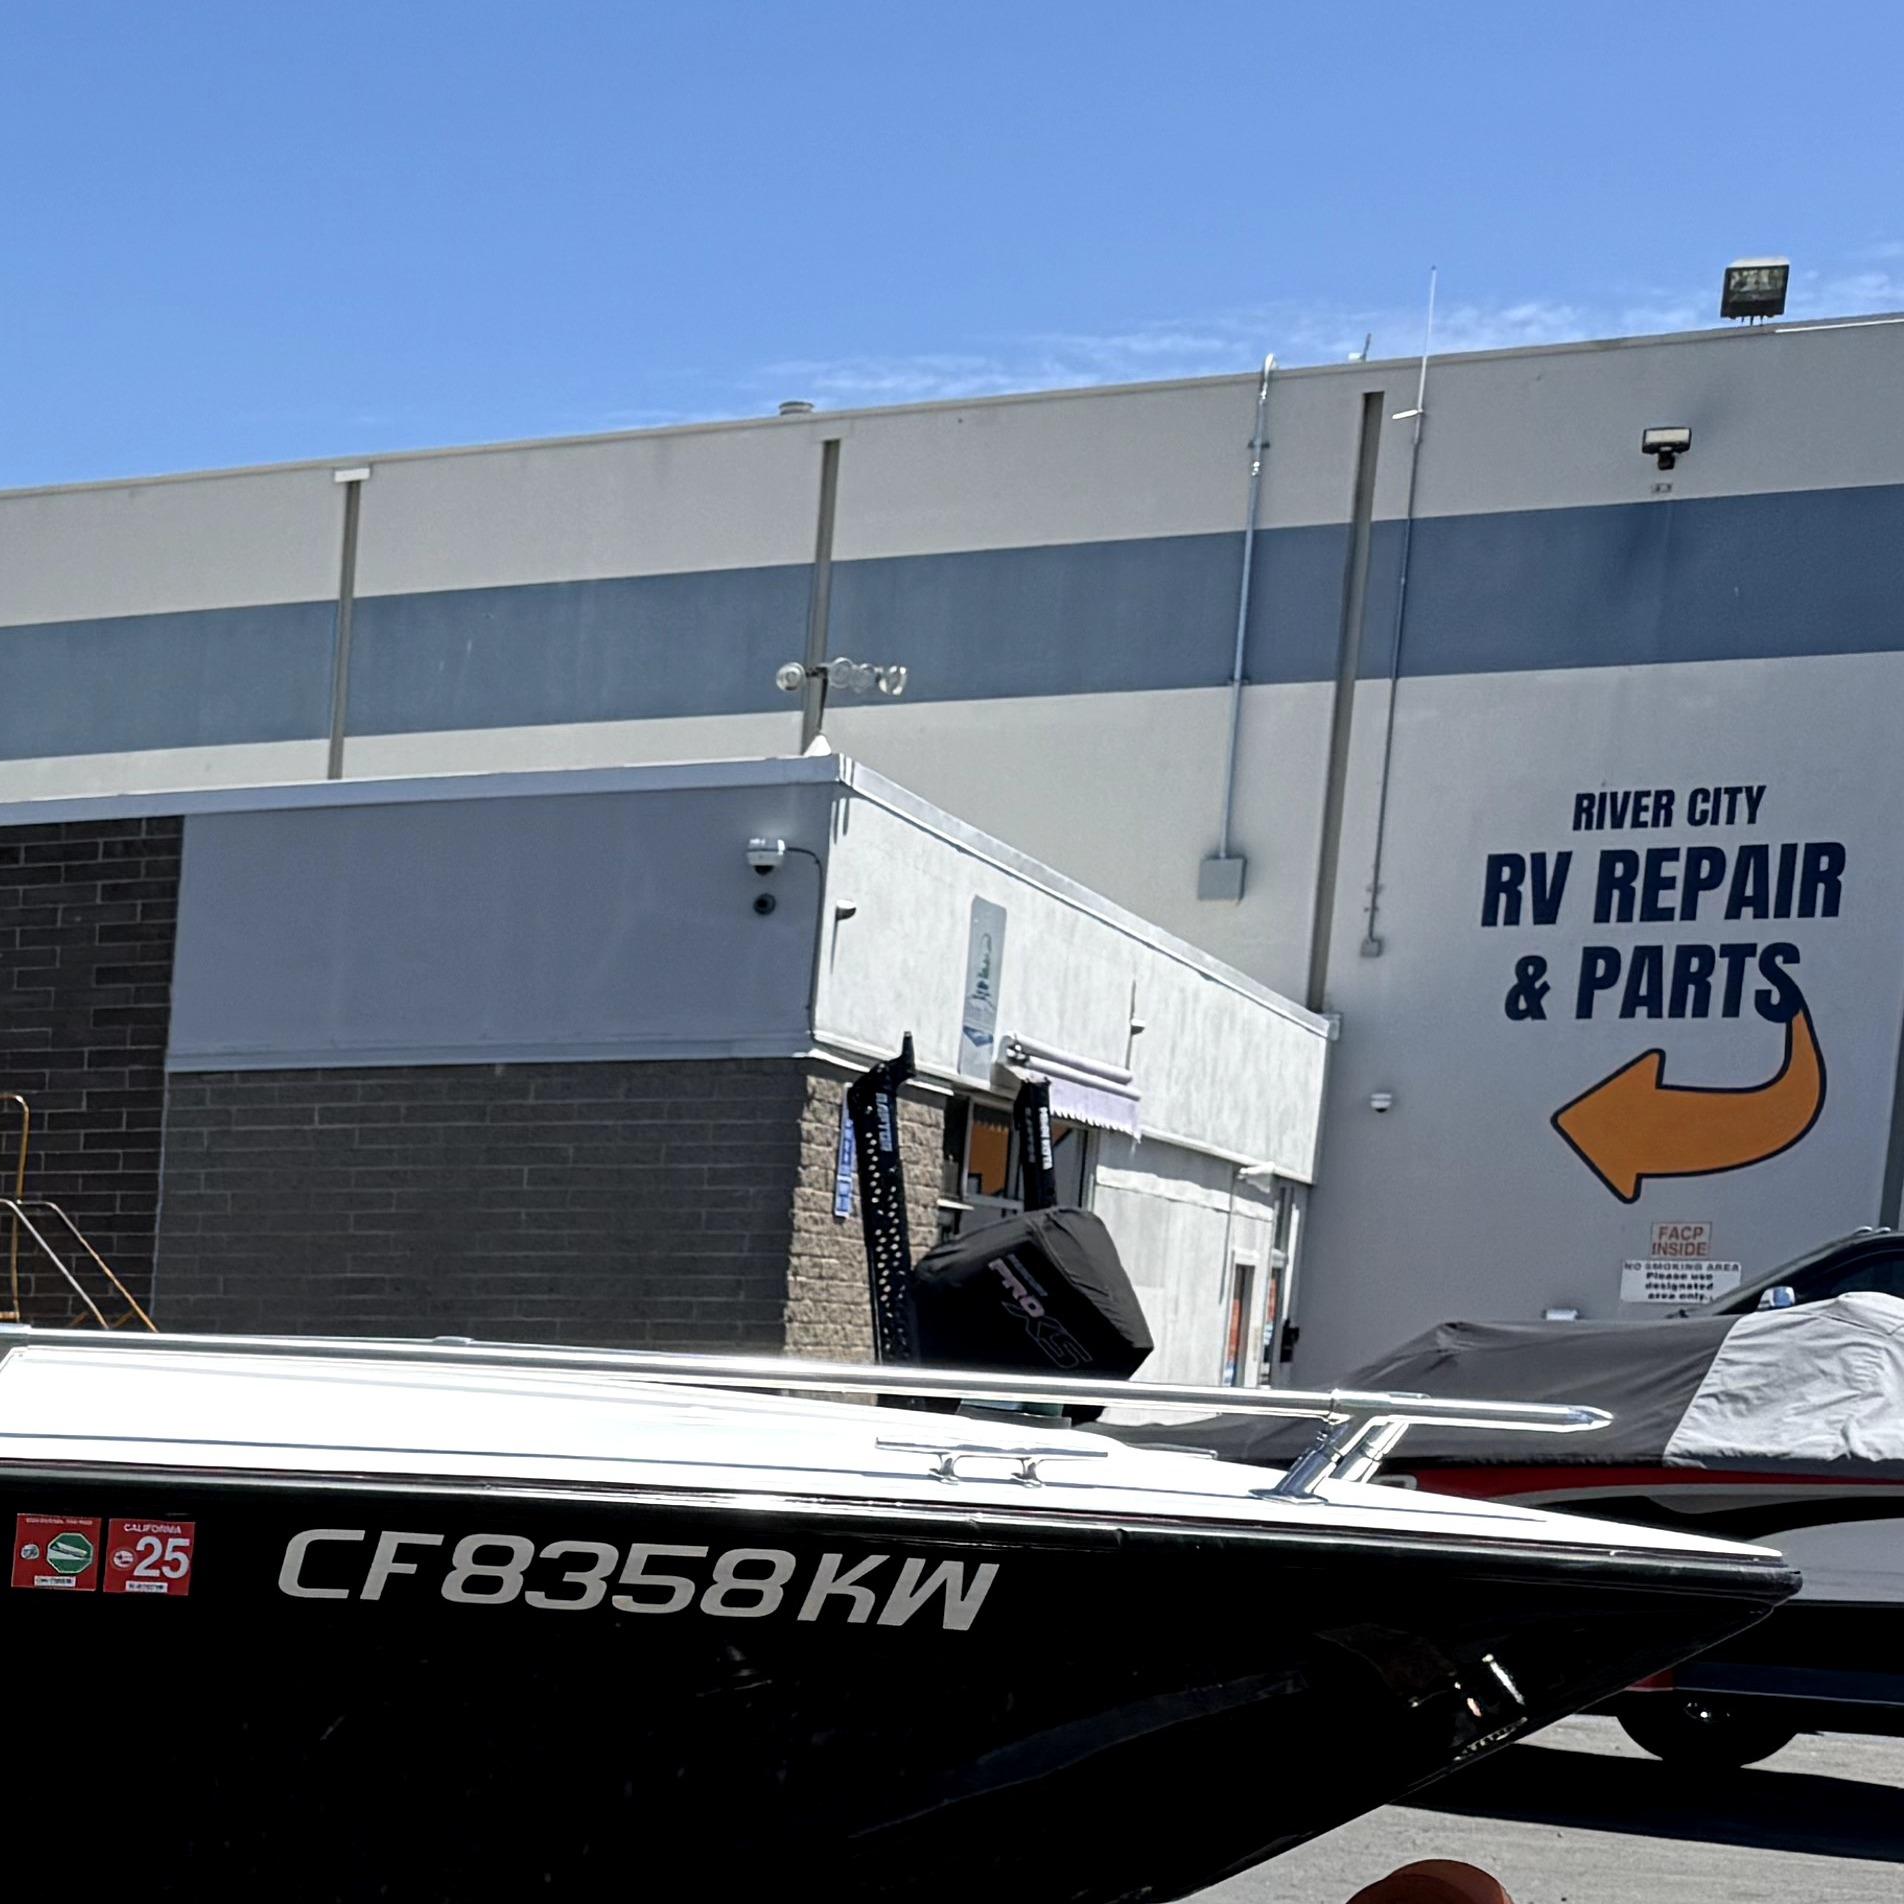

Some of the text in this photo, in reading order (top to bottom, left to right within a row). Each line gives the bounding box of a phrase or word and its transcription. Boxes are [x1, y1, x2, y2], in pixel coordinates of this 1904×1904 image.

[1572, 784, 1767, 831] RIVER CITY
[1480, 841, 1847, 927] RV REPAIR
[1503, 942, 1802, 1024] & PARTS
[1657, 1225, 1705, 1241] FACP
[1651, 1241, 1708, 1257] INSIDE
[1624, 1263, 1740, 1272] NO SMOKING AREA
[1646, 1272, 1688, 1280] Please
[988, 1257, 1045, 1318] PRO
[1645, 1282, 1714, 1292] designated
[123, 1523, 182, 1535] CALIFORNIA
[133, 1536, 190, 1579] 25
[277, 1528, 1000, 1631] CF8358KW
